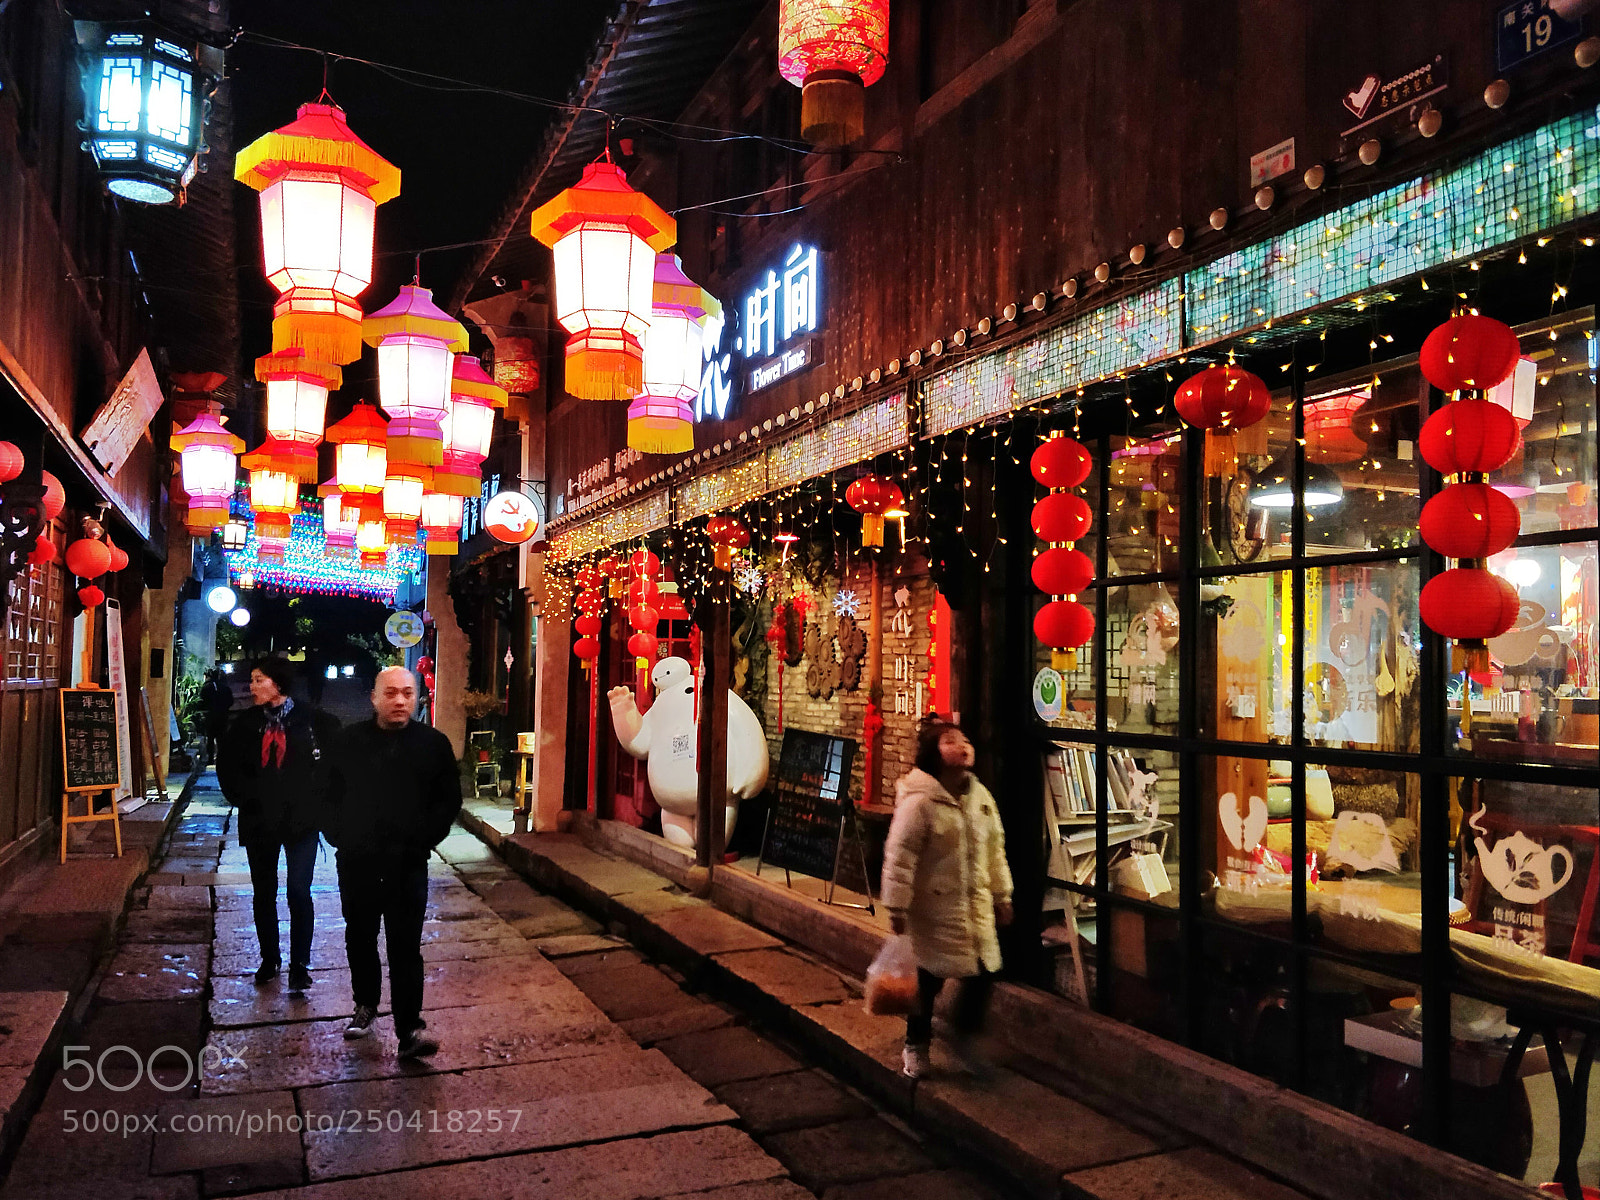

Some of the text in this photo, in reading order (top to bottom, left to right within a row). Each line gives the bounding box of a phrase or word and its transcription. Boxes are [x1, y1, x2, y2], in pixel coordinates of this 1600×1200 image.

[1521, 15, 1552, 52] 19
[752, 348, 806, 391] Flower Time
